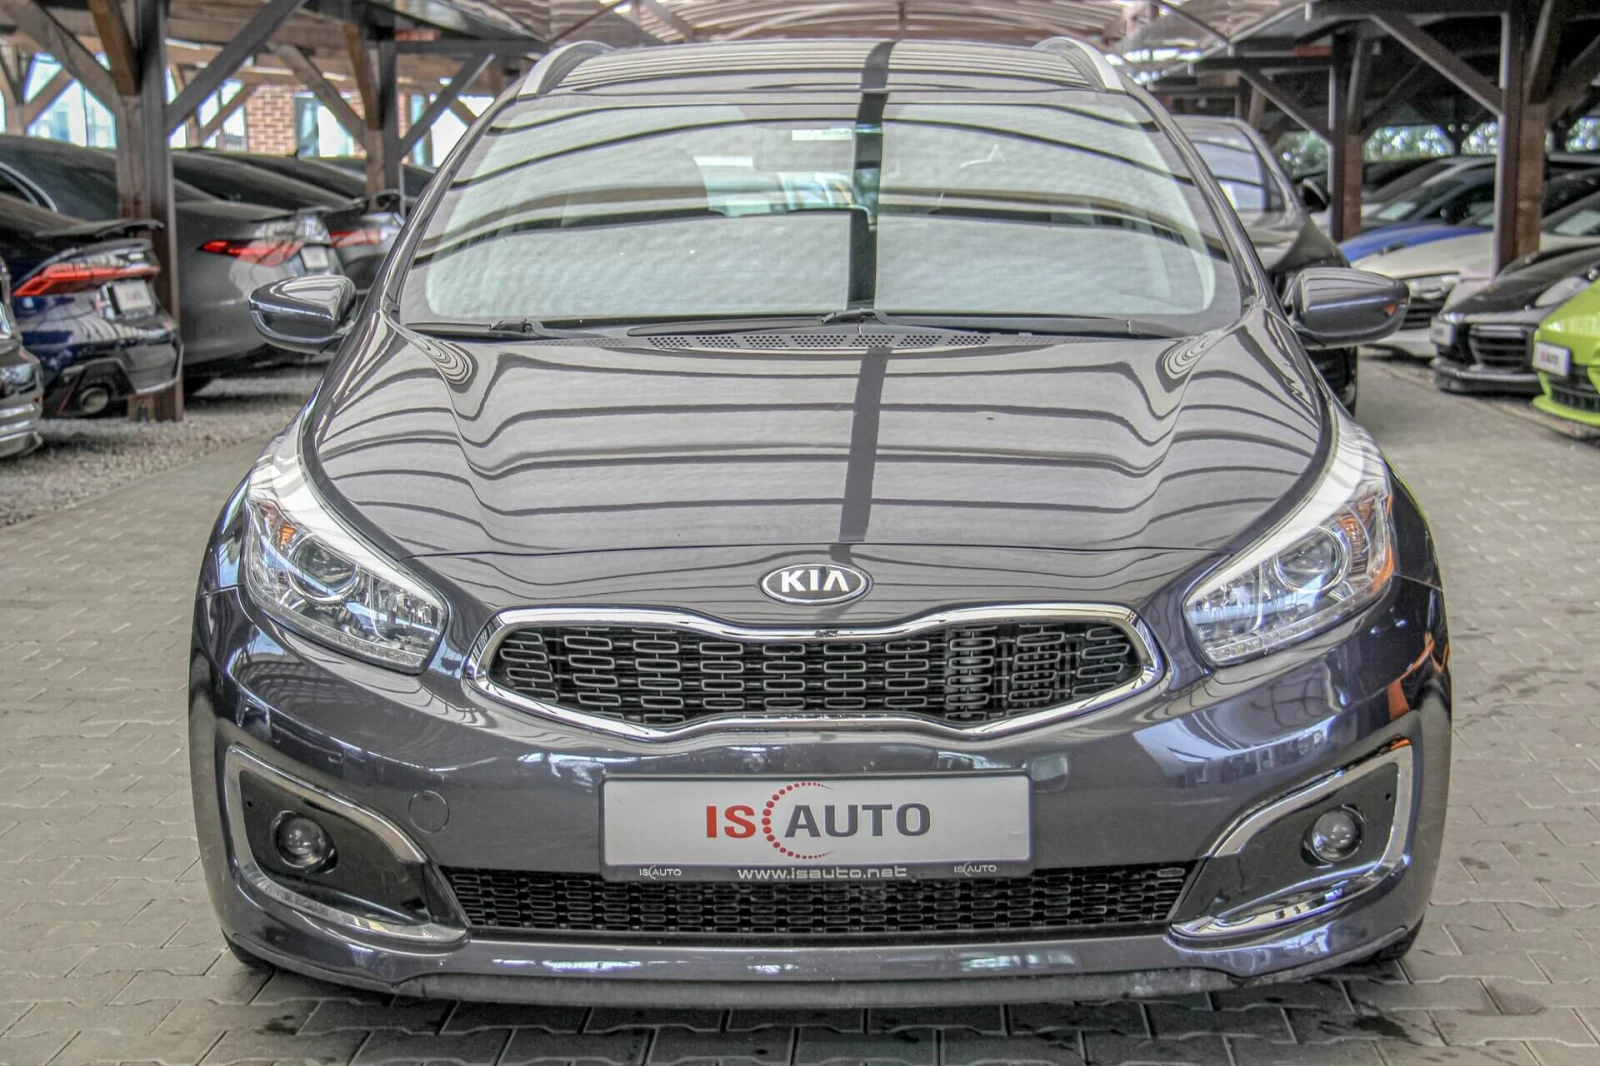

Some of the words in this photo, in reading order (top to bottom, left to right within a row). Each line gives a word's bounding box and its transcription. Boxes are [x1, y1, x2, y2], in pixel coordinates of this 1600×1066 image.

[780, 569, 850, 593] KIA
[706, 805, 757, 839] IS
[784, 803, 931, 838] AUTO
[737, 866, 907, 879] www.isauto.net
